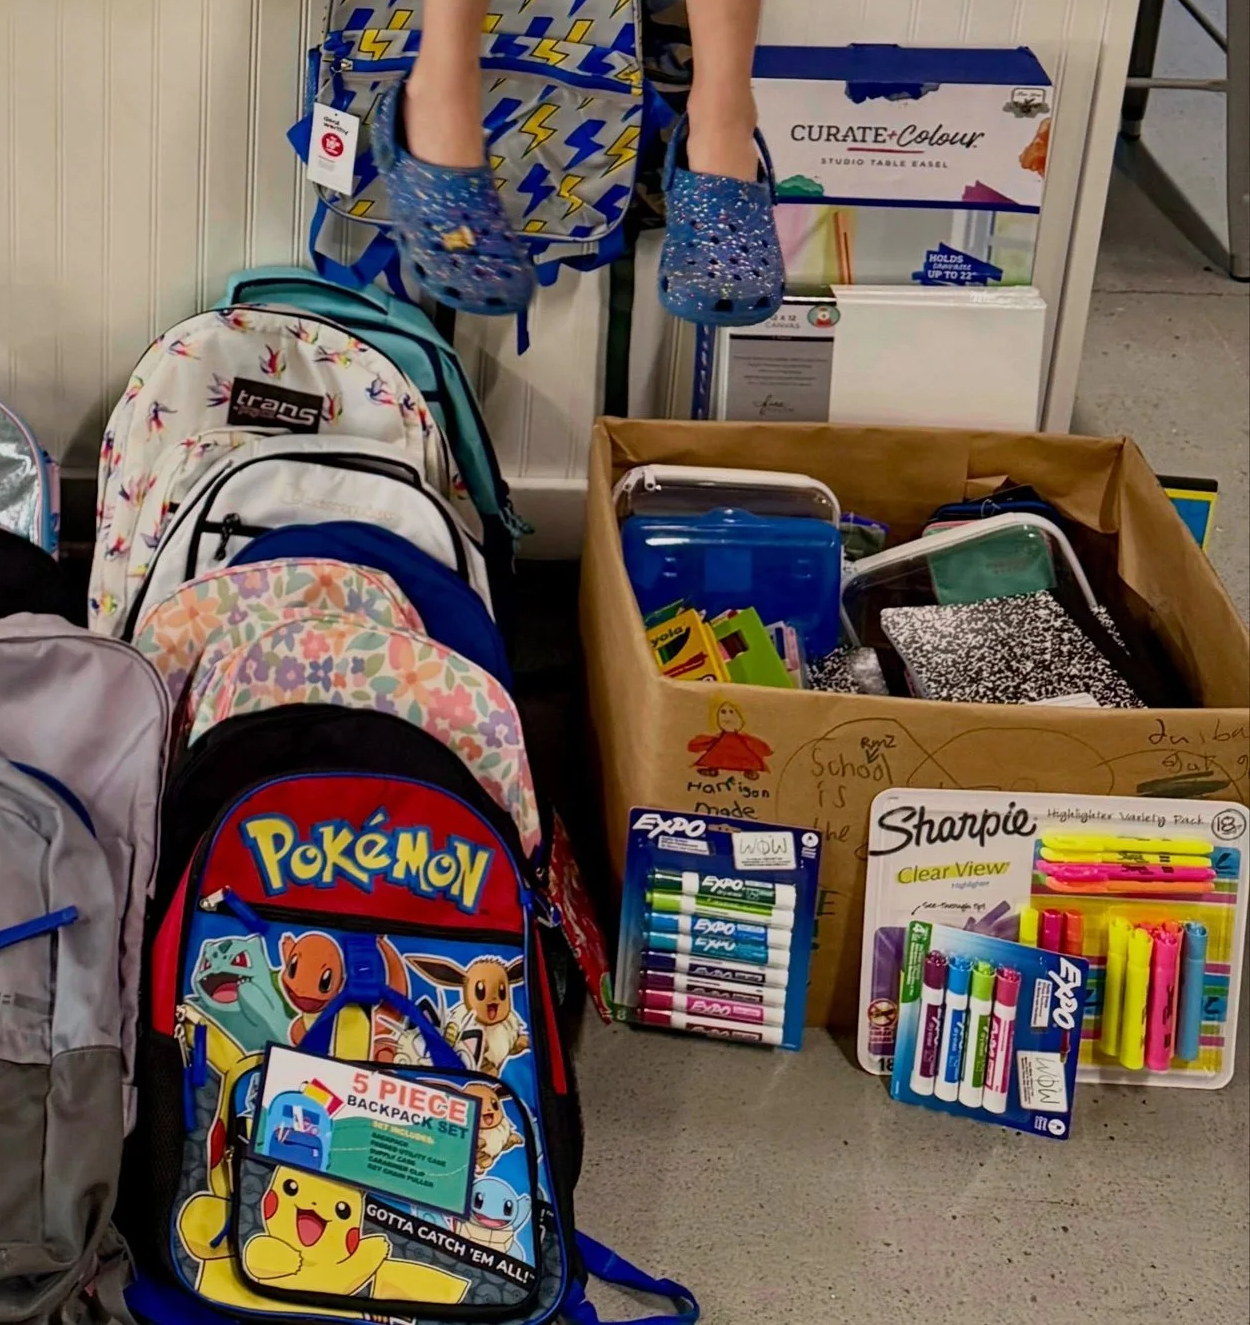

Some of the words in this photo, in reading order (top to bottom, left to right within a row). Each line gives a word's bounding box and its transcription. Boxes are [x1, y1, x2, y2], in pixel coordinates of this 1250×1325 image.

[821, 158, 865, 166] STUDIO
[871, 159, 907, 167] TABLE
[911, 160, 949, 169] EASEL
[929, 253, 964, 263] HOLDS
[927, 270, 944, 279] UP
[945, 270, 958, 279] TO
[237, 389, 319, 426] trans
[811, 747, 893, 785] School
[817, 780, 847, 809] is
[694, 800, 759, 820] made
[1047, 808, 1114, 823] Highlighter
[1119, 810, 1167, 826] Variety
[1173, 813, 1204, 826] Pack
[631, 813, 707, 840] EXPO
[869, 801, 1039, 857] Sharpie
[1215, 815, 1236, 833] 18
[701, 875, 744, 891] EXPO
[897, 864, 952, 886] Clear
[954, 861, 1005, 879] View
[693, 918, 736, 935] EXPO
[1047, 957, 1083, 1030] EXPO
[690, 1000, 732, 1016] EXPO
[352, 1071, 370, 1094] 5
[379, 1078, 469, 1125] PIECE
[346, 1094, 433, 1130] BACKPACK
[437, 1122, 470, 1140] SET
[365, 1203, 415, 1235] GOTTA
[417, 1226, 466, 1257] CATCH
[469, 1248, 494, 1267] 'EM
[496, 1258, 530, 1284] ALL!
